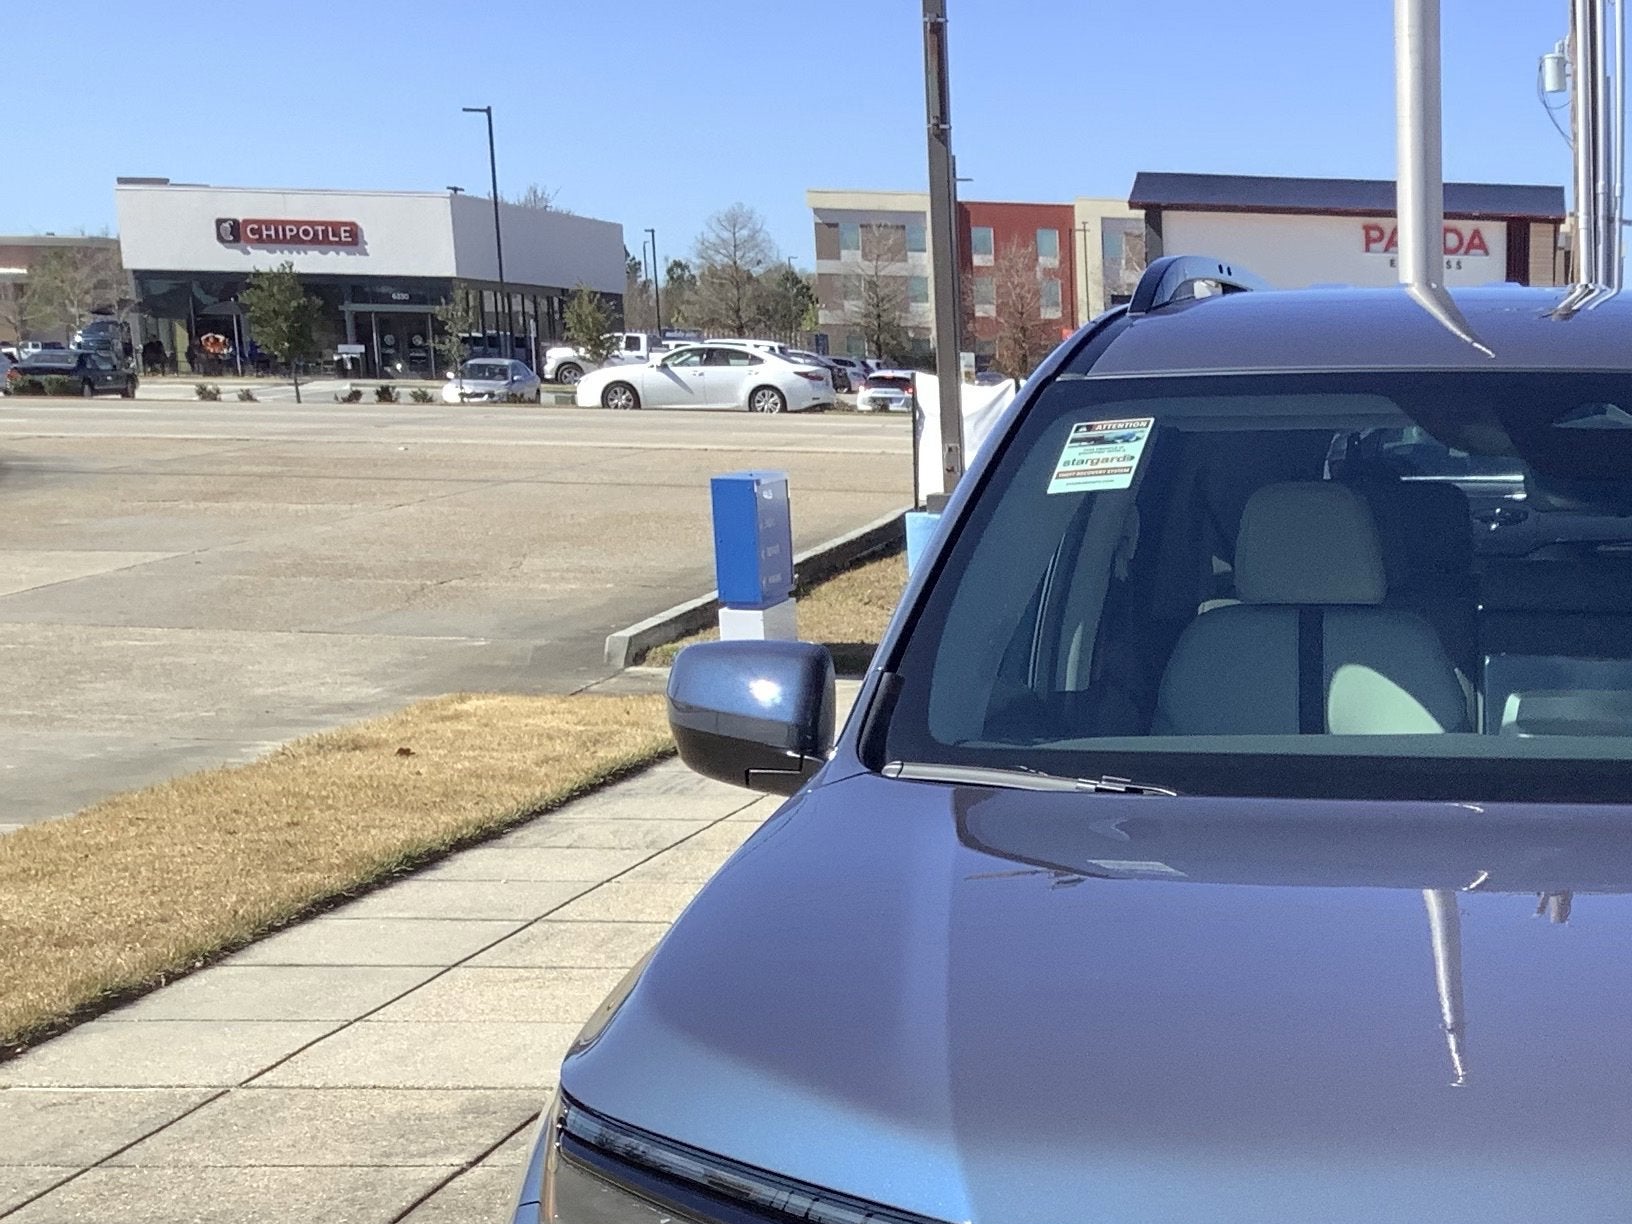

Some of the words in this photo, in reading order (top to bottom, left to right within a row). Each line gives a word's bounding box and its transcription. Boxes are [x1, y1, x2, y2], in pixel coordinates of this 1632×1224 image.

[246, 223, 353, 242] CHIPOTLE
[1363, 224, 1490, 256] PADA
[1095, 421, 1148, 430] ATTENTION
